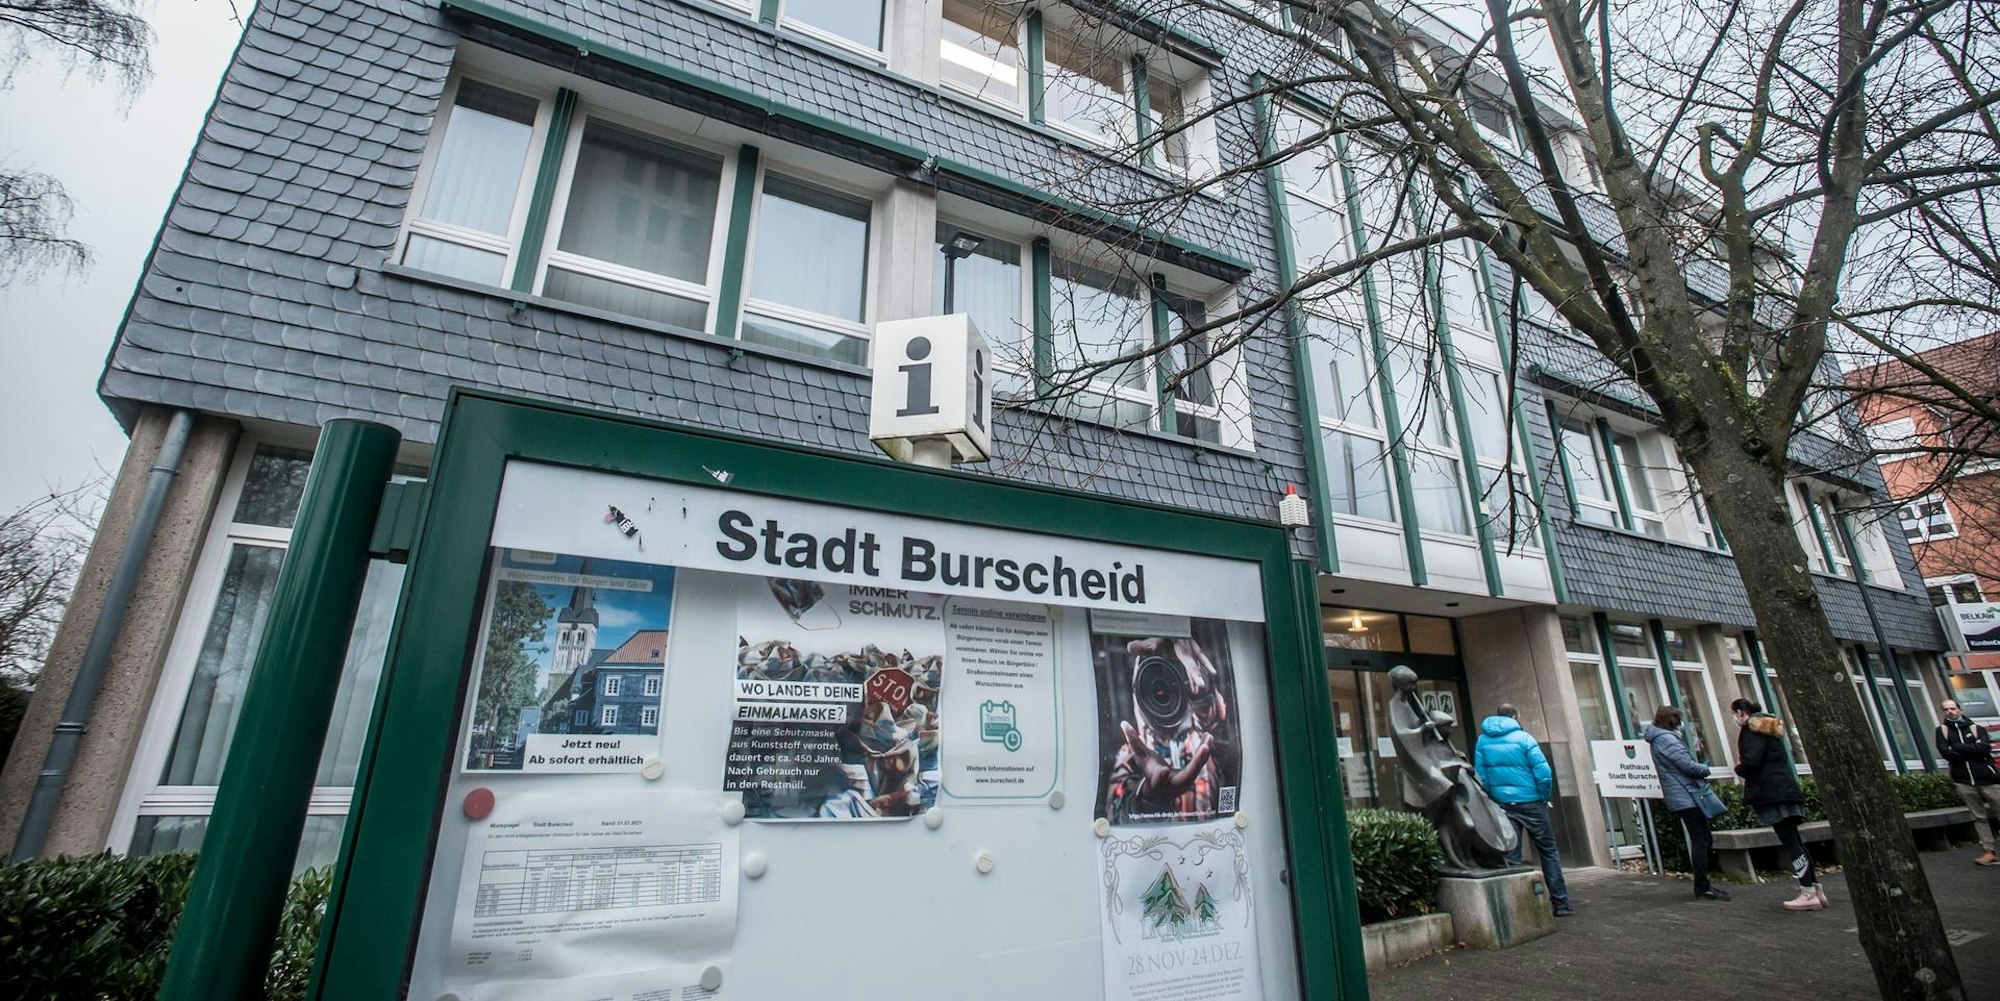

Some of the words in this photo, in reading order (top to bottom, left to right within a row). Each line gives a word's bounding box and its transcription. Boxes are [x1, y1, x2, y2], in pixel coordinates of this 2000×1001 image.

[716, 509, 881, 577] Stadt
[901, 536, 1146, 604] Burscheid
[507, 571, 565, 583] Wissenswertes
[568, 573, 581, 583] für
[582, 574, 608, 587] Bürger
[609, 578, 625, 588] und
[849, 585, 909, 599] IMMER
[849, 599, 940, 620] SCHMUTZ.
[952, 605, 979, 616] Termin
[980, 608, 1003, 618] online
[1005, 610, 1047, 622] vereinbaren
[1960, 612, 1995, 620] BELKAW
[1013, 628, 1035, 636] Anliegen
[956, 634, 993, 643] Bürgerservice
[975, 680, 1013, 688] Wunschtermin
[741, 683, 764, 695] WO
[768, 684, 819, 697] LANDET
[824, 686, 860, 699] DEINE
[738, 705, 844, 721] EINMALMASKE?
[985, 714, 1010, 722] Termin
[733, 727, 748, 736] Bis
[751, 728, 771, 736] eine
[774, 728, 835, 738] Schutzmaske
[561, 739, 592, 749] Jetzt
[595, 740, 621, 749] neu!
[751, 740, 801, 750] Kunststoff
[802, 742, 842, 752] verottet,
[529, 755, 545, 764] Ab
[549, 755, 585, 764] sofort
[588, 755, 644, 765] erhältlich
[729, 753, 761, 762] dauert
[777, 755, 792, 763] ca.
[794, 754, 812, 763] 450
[814, 755, 842, 764] Jahre.
[727, 767, 753, 776] Nach
[756, 767, 802, 776] Gebrauch
[804, 768, 820, 776] nur
[1620, 763, 1650, 771] Rathaus
[726, 780, 736, 788] in
[739, 780, 758, 789] den
[761, 780, 806, 789] Restmüll.
[1792, 854, 1809, 871] NIKE
